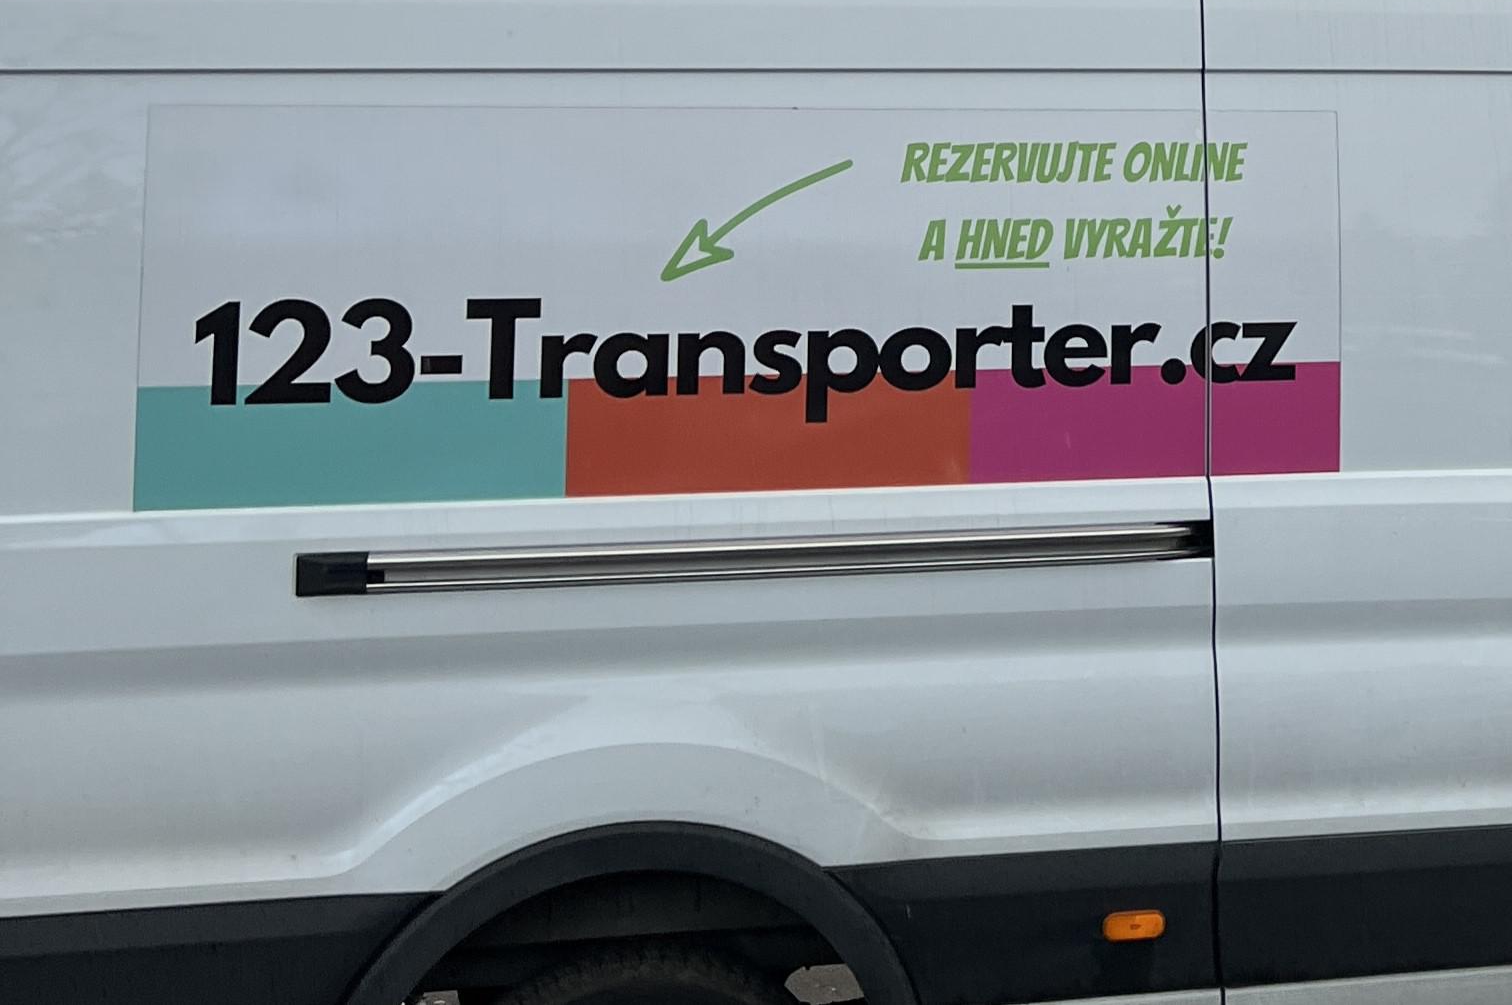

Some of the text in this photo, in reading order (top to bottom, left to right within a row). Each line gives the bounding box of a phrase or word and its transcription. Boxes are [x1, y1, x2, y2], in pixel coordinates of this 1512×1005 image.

[900, 141, 1249, 184] REZERVUJTE ONLINE
[918, 204, 1234, 269] A HNED VYRAŽTE!
[194, 297, 1298, 424] 123-Transporter.cz
